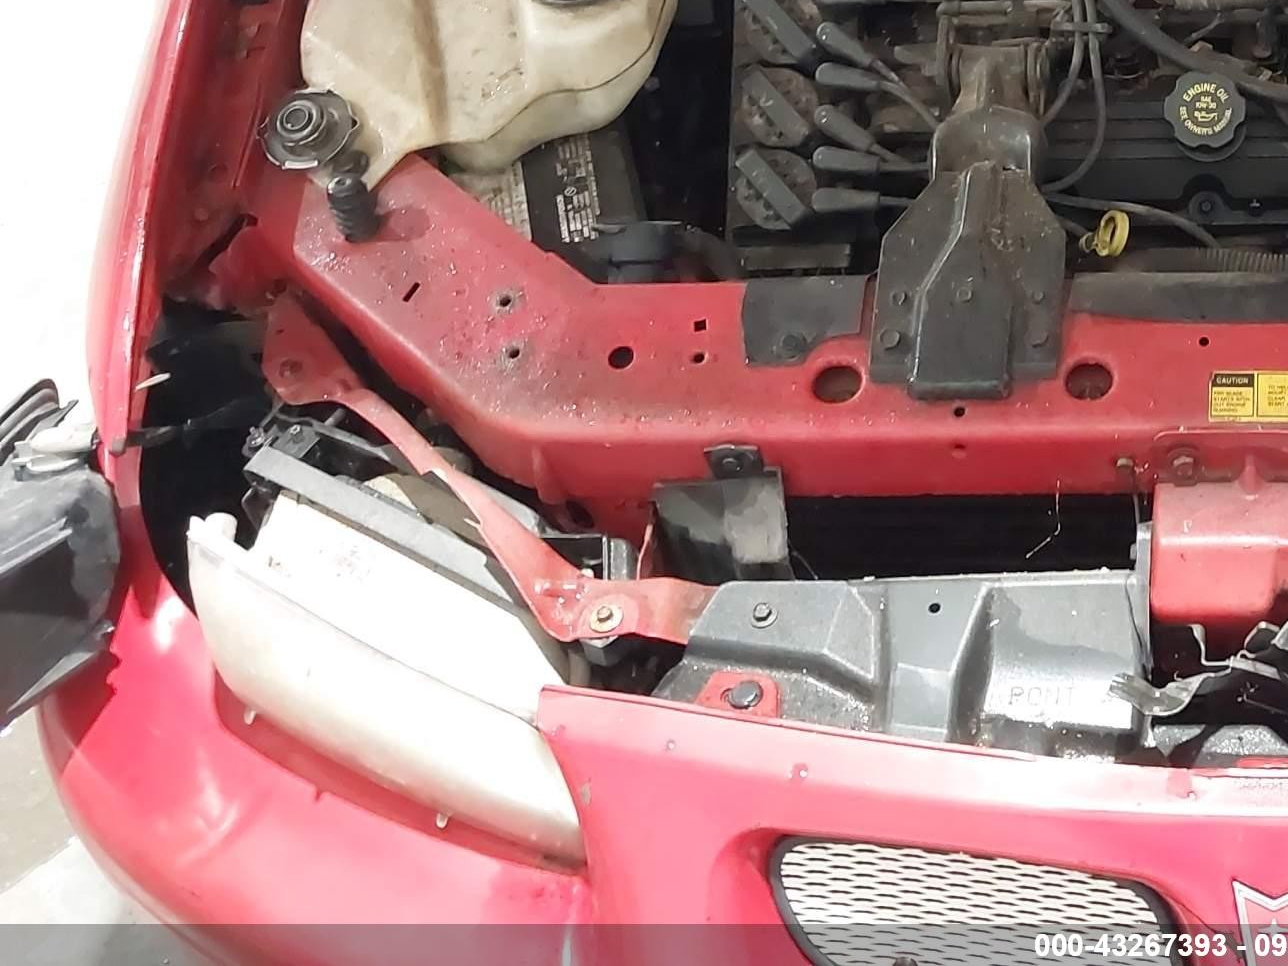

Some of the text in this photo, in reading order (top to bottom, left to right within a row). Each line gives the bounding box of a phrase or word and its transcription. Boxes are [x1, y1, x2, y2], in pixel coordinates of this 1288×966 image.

[1183, 82, 1231, 104] ENGINE OIL
[1180, 105, 1189, 121] SEE
[1216, 376, 1249, 385] CAUTION
